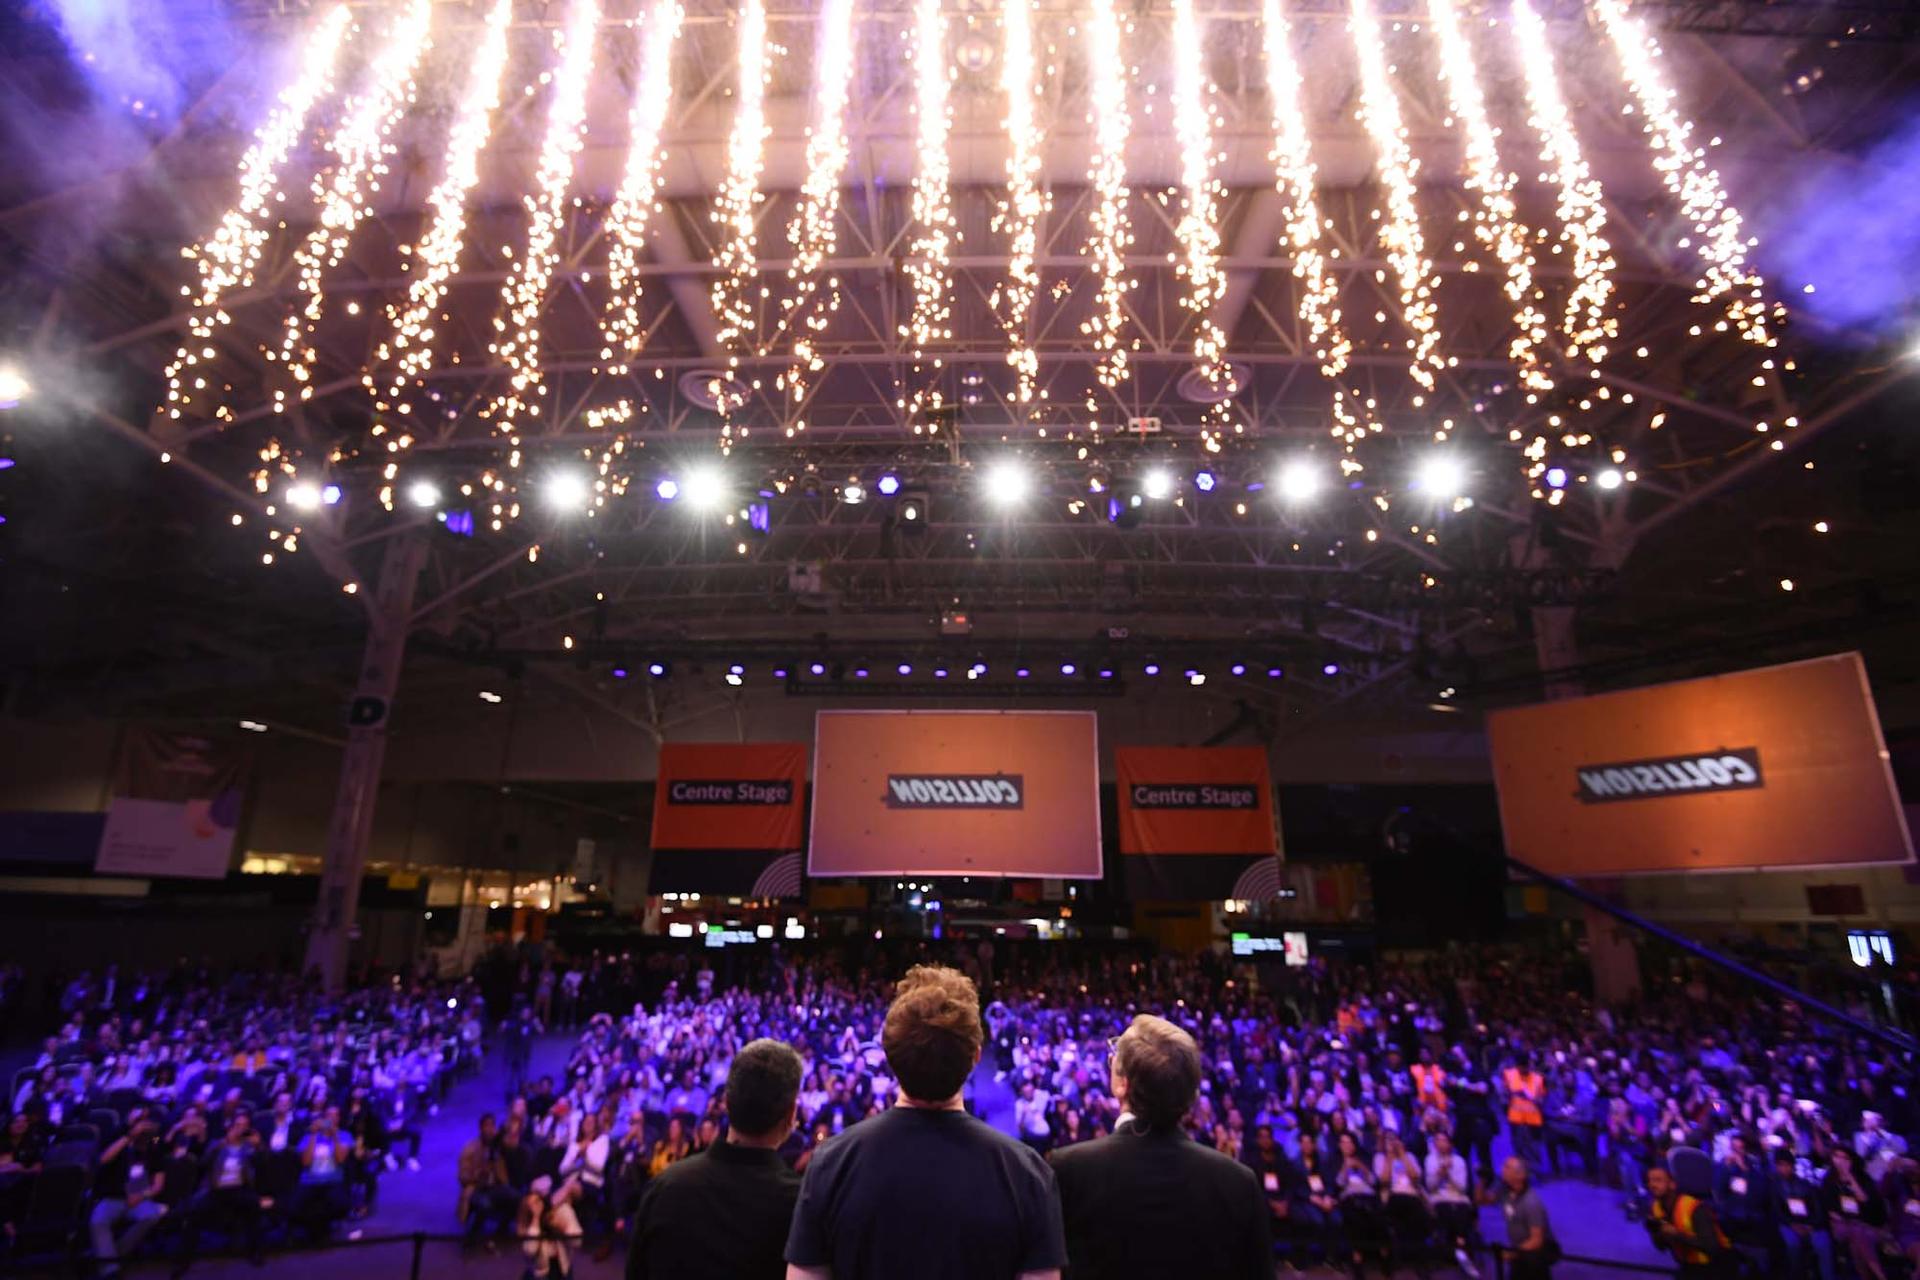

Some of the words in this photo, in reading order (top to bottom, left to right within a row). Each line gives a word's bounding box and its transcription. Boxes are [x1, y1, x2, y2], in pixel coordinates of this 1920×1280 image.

[672, 783, 733, 801] Centre
[737, 783, 787, 803] Stage
[1135, 786, 1197, 804] Centre
[1200, 787, 1253, 807] Stage
